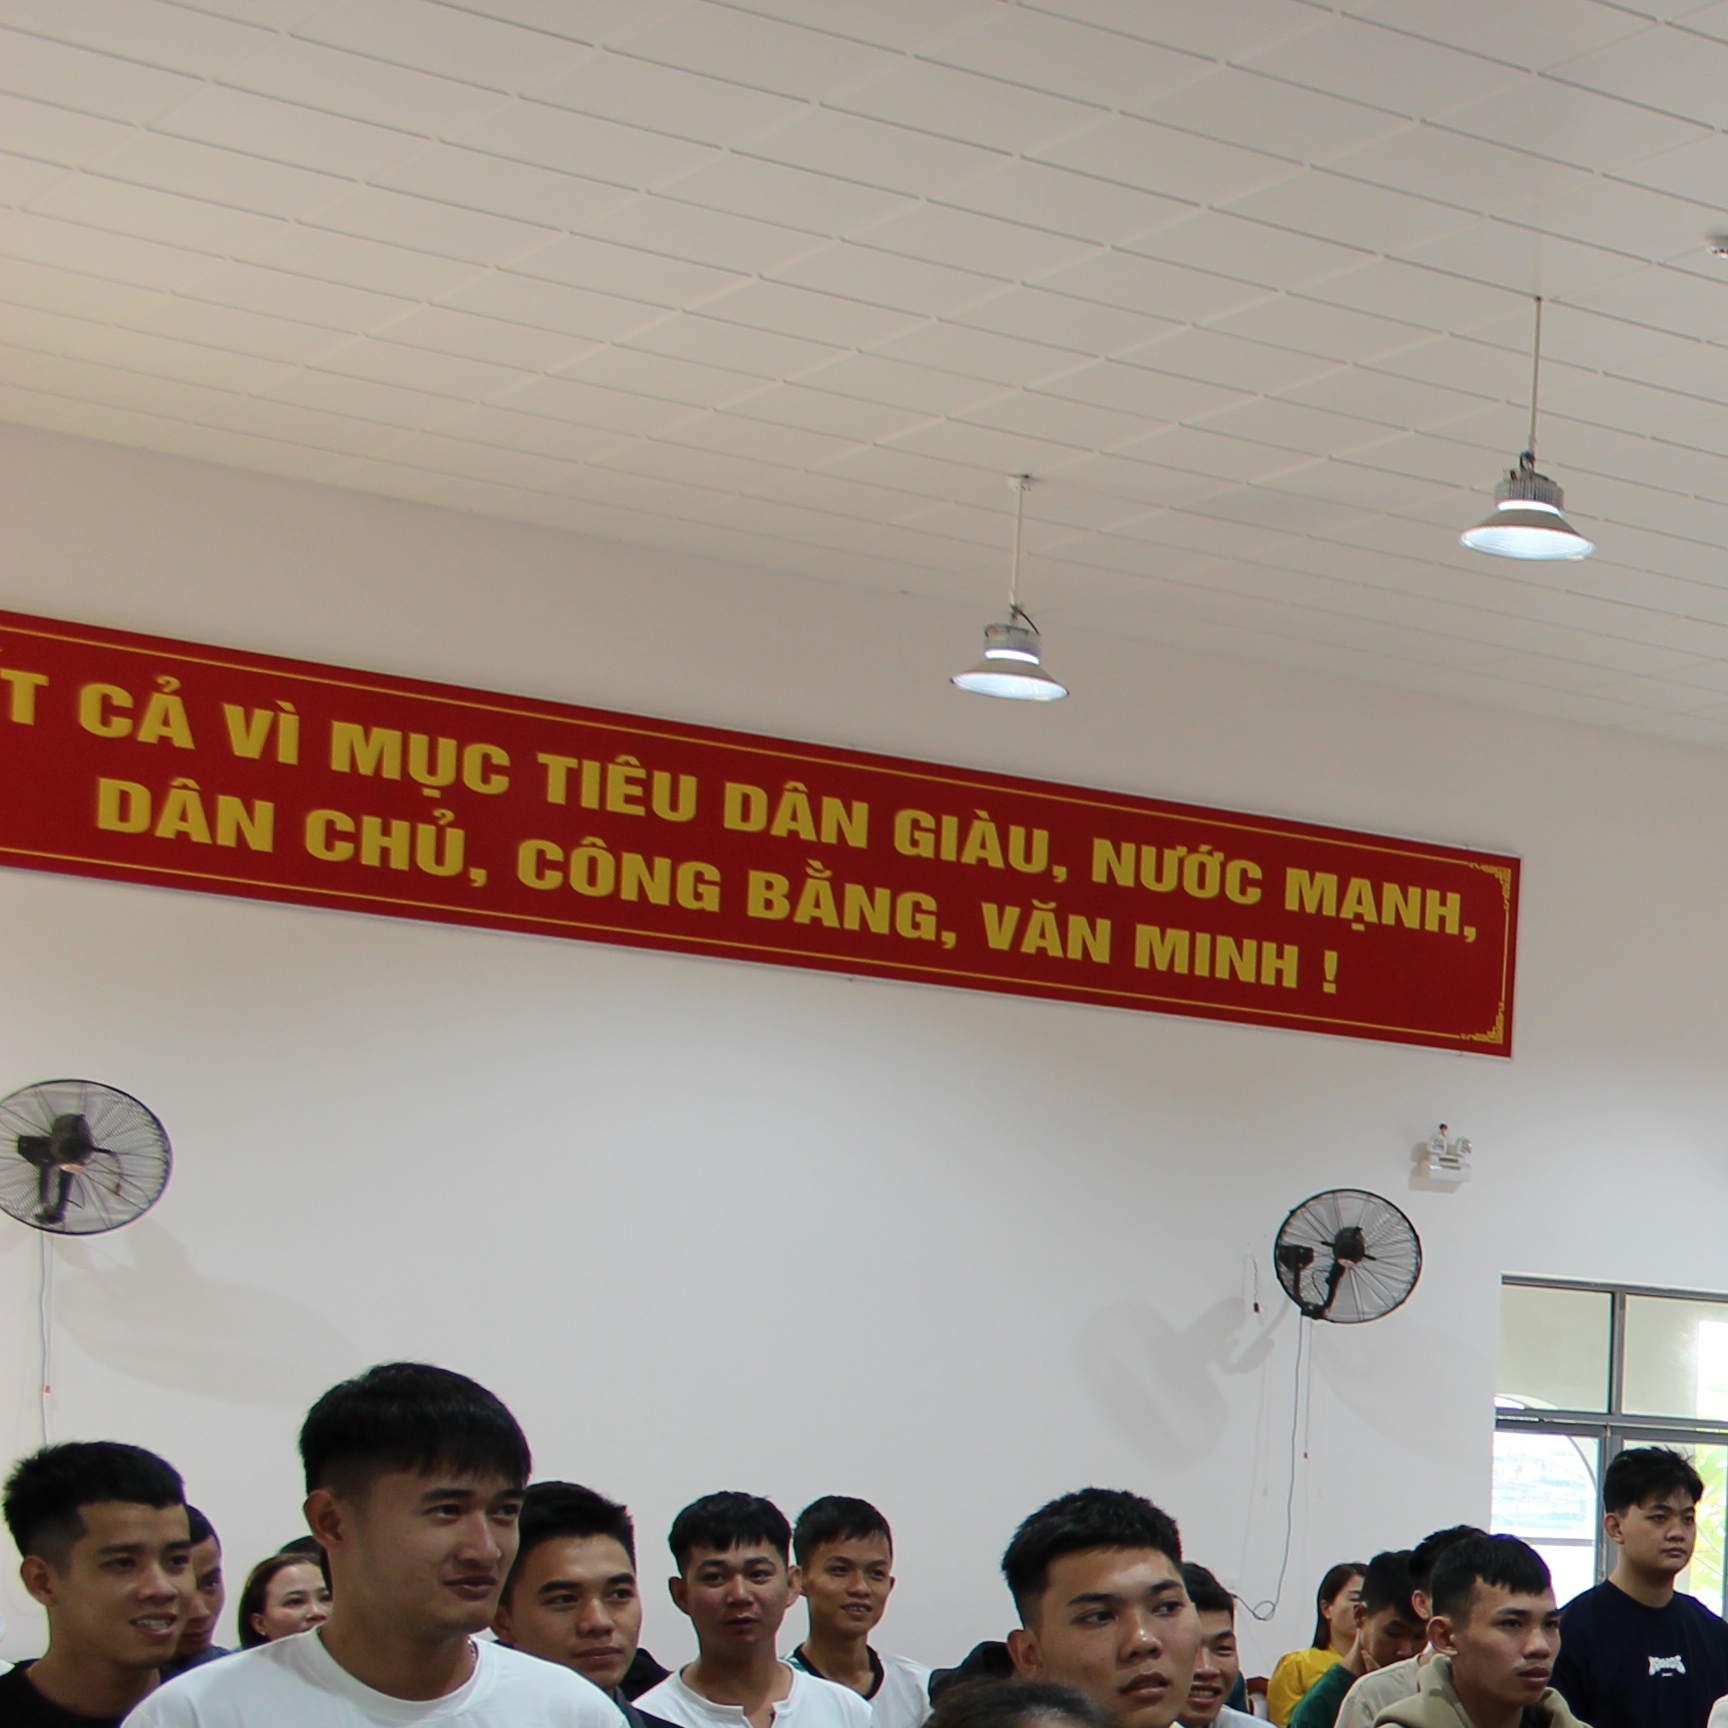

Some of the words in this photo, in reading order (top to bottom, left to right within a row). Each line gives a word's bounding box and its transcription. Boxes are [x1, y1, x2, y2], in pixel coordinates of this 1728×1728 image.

[0, 668, 48, 724] T
[79, 676, 194, 749] CẢ
[223, 701, 299, 764] VÌ
[331, 721, 510, 798] MỤC
[537, 753, 697, 822] TIÊU
[724, 781, 869, 848] DÂN
[894, 809, 1067, 883] GIÀU,
[1092, 838, 1263, 905] NƯỚC
[1285, 868, 1476, 942] MẠNH,
[97, 778, 274, 852] DÂN
[305, 809, 487, 887] CHỦ,
[518, 837, 721, 912] CÔNG
[747, 860, 956, 949] BẰNG,
[982, 900, 1111, 964] VĂN
[1135, 924, 1299, 988] MINH
[1323, 951, 1338, 993] !
